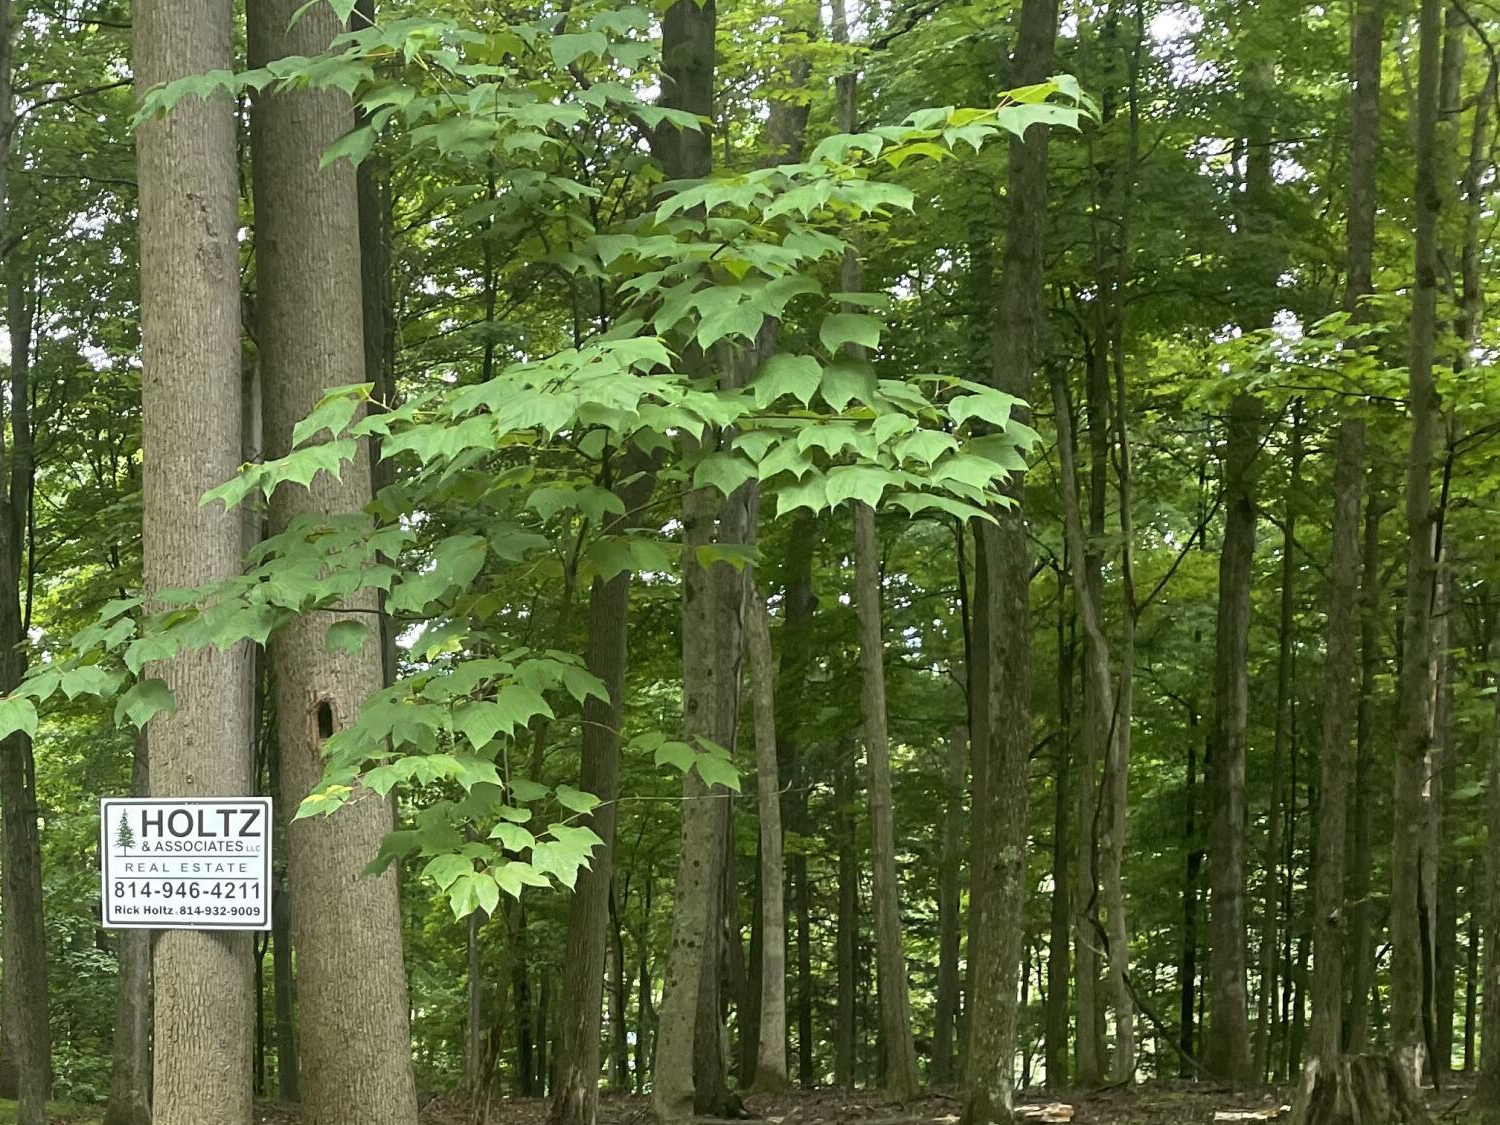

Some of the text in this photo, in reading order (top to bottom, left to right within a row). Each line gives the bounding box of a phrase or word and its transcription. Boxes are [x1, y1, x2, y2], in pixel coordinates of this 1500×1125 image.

[142, 809, 261, 838] HOLTZ
[142, 841, 151, 852] &
[155, 840, 244, 852] ASSOCIATES
[125, 862, 248, 873] REAL ESTATE
[114, 881, 260, 899] 814-946-4211
[115, 905, 261, 916] Rick Holtz 814-932-9009
